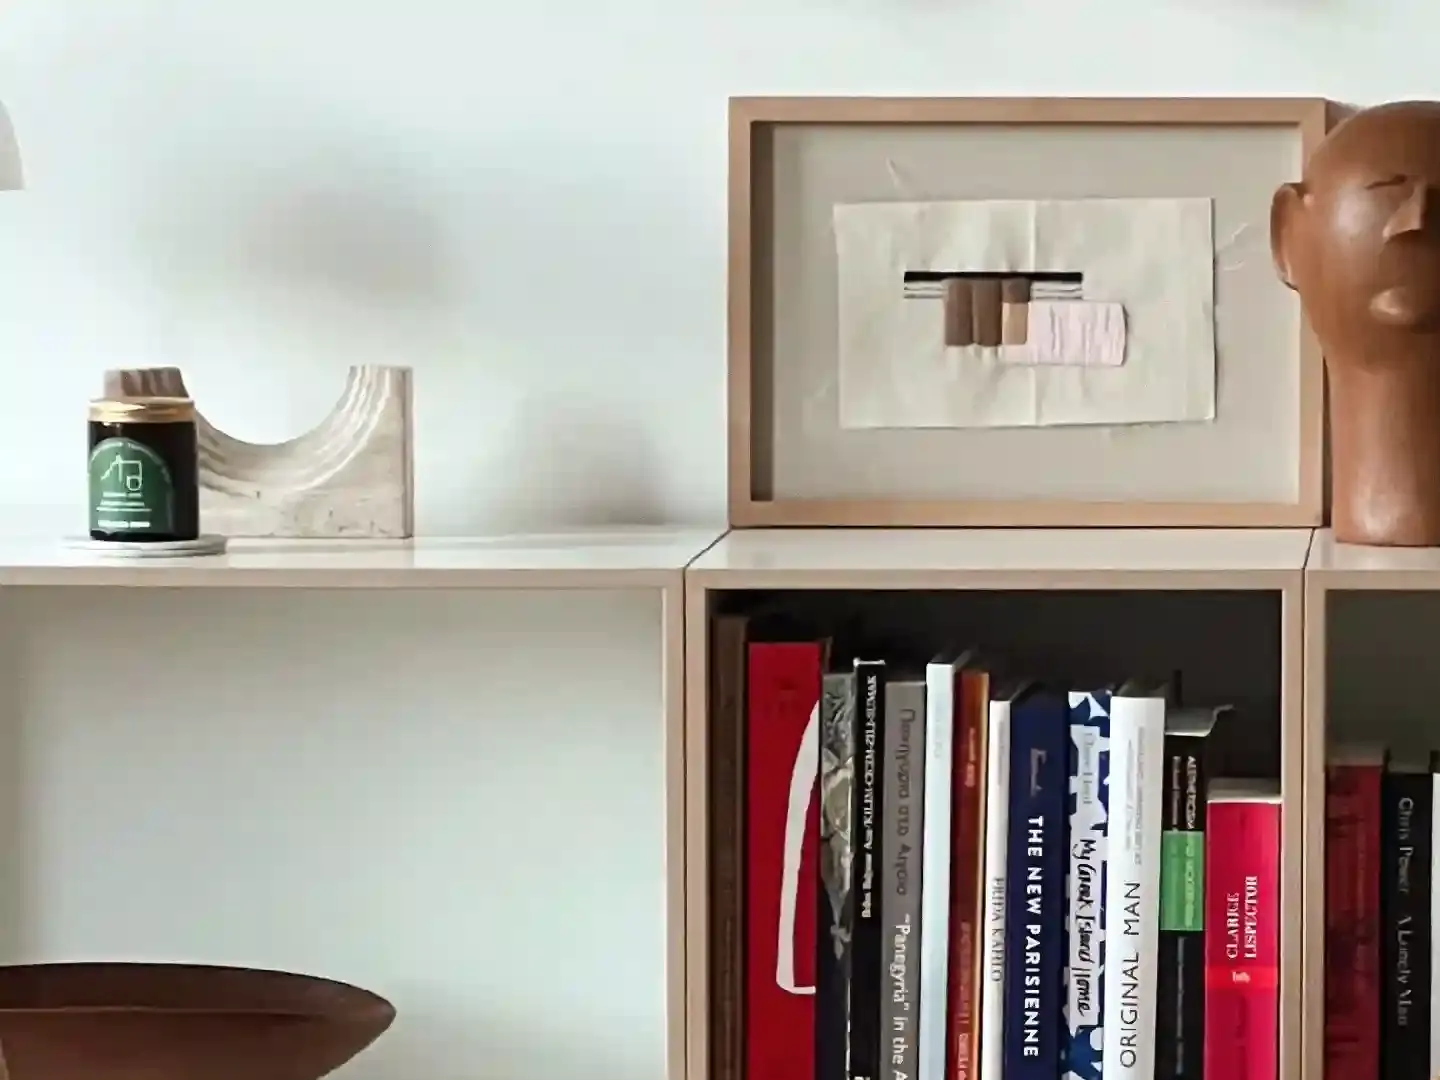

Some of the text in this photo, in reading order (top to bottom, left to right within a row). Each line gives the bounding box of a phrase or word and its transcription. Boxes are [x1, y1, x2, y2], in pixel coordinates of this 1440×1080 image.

[1026, 815, 1045, 857] THE
[1396, 797, 1415, 839] Chris
[1071, 839, 1098, 861] My
[1025, 866, 1044, 914] NEW
[1123, 881, 1142, 936] MAN
[1075, 915, 1097, 964] Island
[1226, 891, 1240, 958] CLARICE
[1242, 874, 1258, 959] LISPECTOR
[1022, 924, 1042, 1057] PARISIENNE
[1118, 951, 1140, 1069] ORIGINAL
[892, 1036, 909, 1065] the
